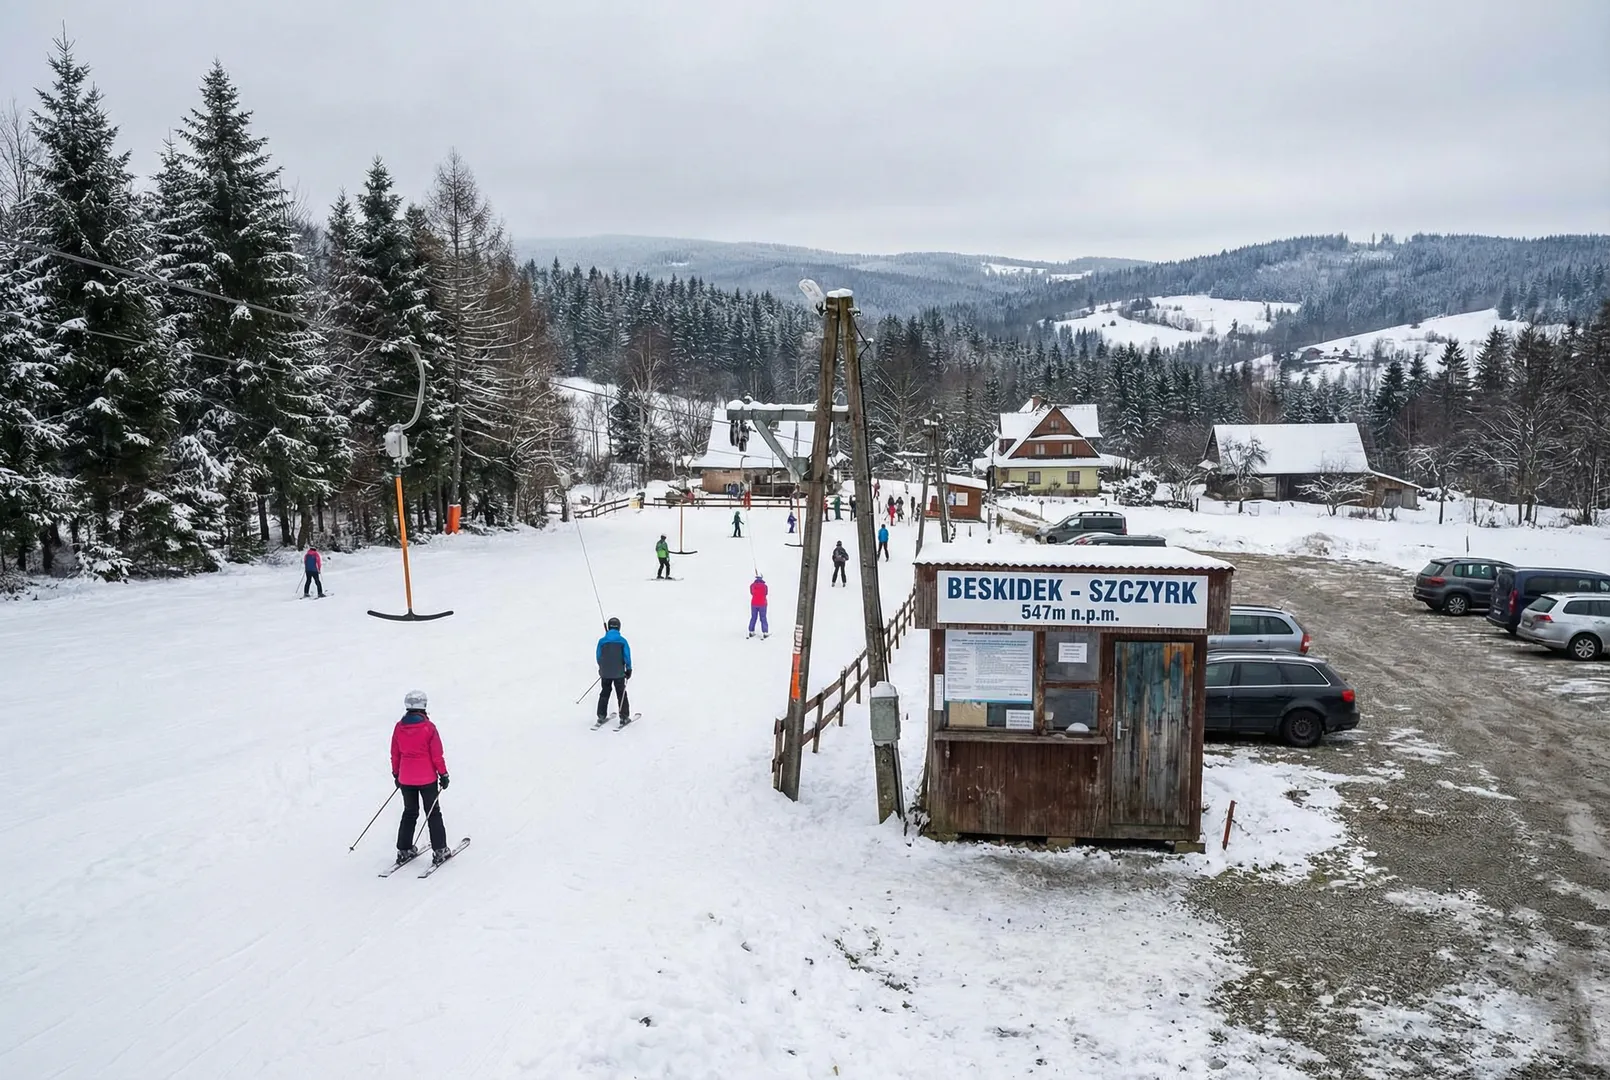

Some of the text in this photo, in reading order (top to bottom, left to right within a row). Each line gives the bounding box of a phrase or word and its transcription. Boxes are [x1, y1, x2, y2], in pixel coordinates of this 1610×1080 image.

[947, 576, 1063, 602] BESKIDEK
[1089, 579, 1198, 605] SZCZYRK
[1021, 604, 1120, 624] 547m n.p.m.
